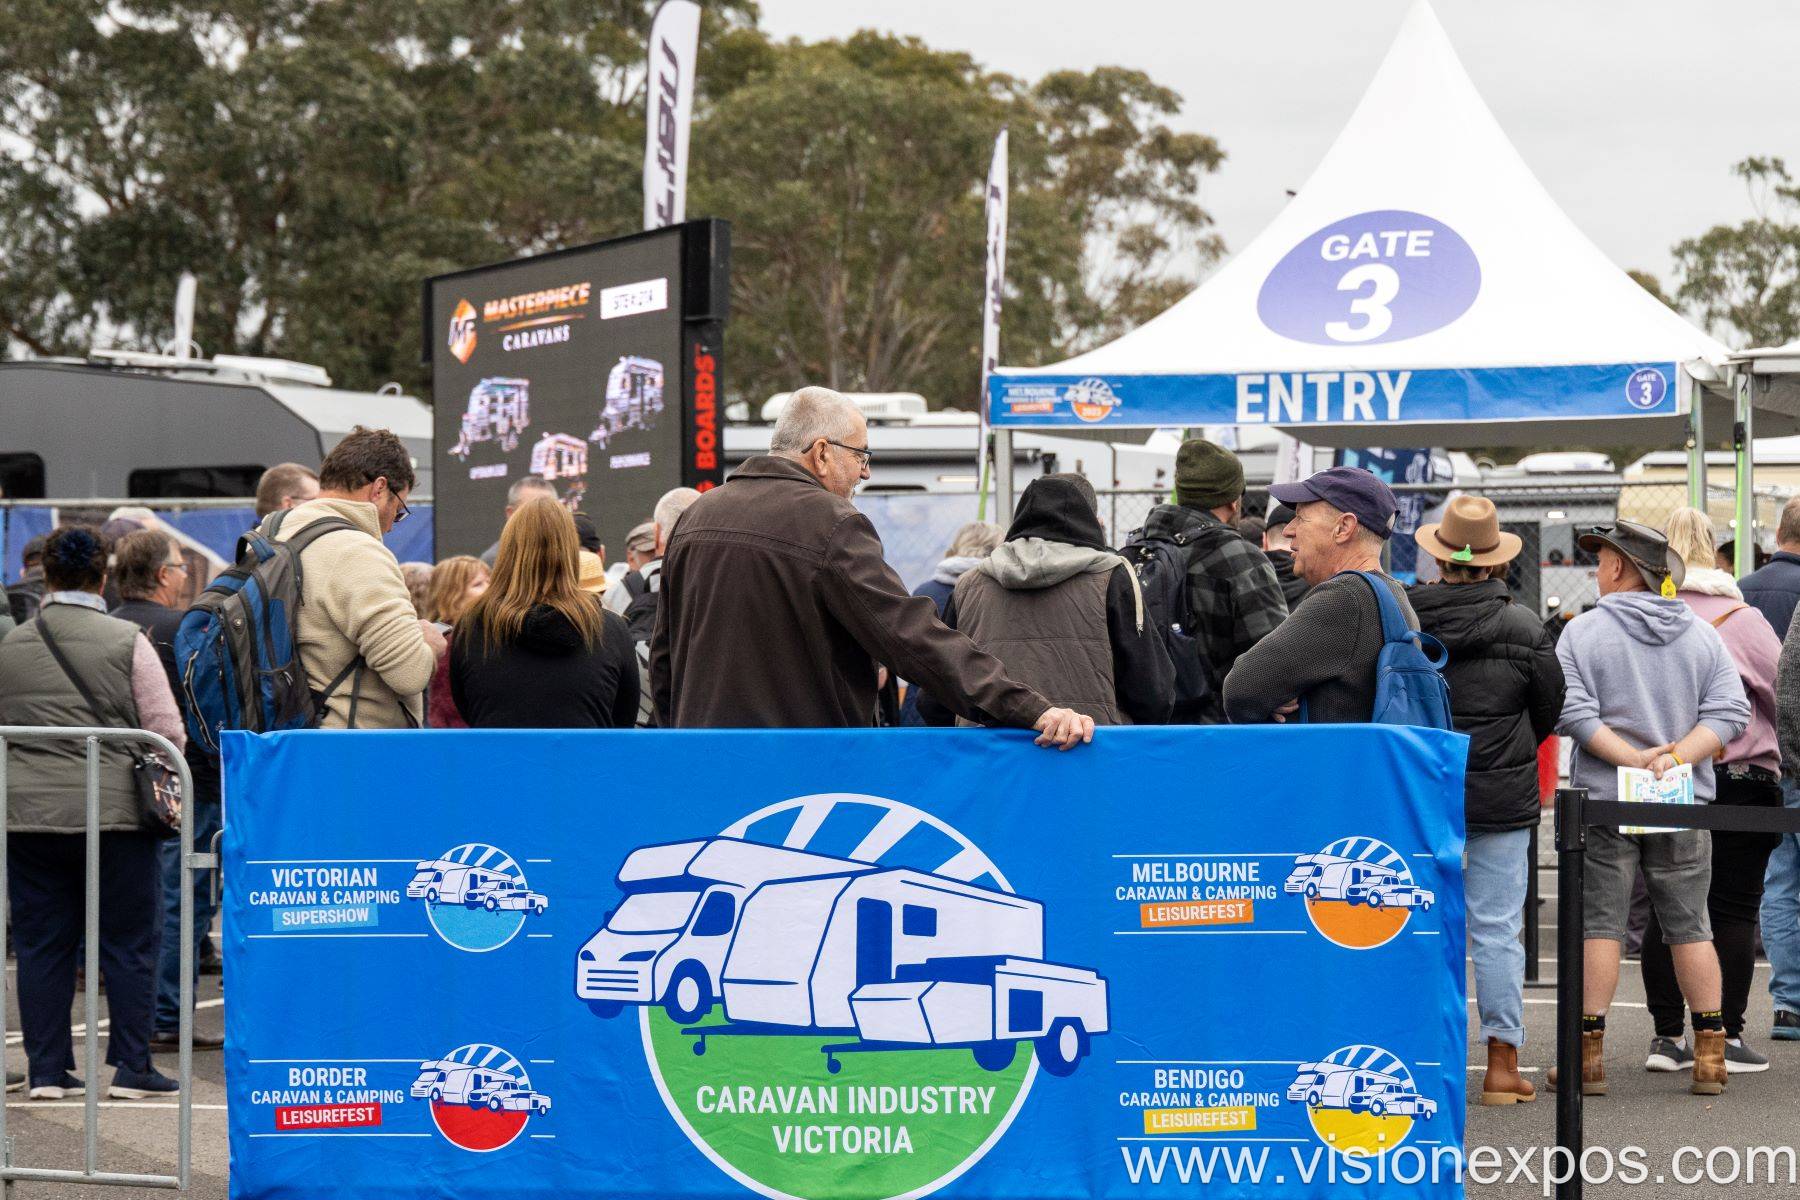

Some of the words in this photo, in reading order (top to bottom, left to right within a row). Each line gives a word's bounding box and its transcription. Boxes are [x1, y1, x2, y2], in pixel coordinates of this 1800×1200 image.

[1321, 230, 1434, 261] GATE
[483, 282, 592, 322] MASTERPIECE
[1325, 263, 1400, 342] 3
[502, 325, 571, 351] CARAVANS
[1636, 373, 1657, 382] GATE
[1236, 371, 1412, 423] ENTRY
[1640, 382, 1653, 405] 3
[694, 354, 717, 470] BOARDS
[271, 868, 378, 888] VICTORIAN
[1132, 861, 1260, 883] MELBOURNE
[249, 890, 318, 906] CARAVAN
[320, 890, 331, 905] &
[333, 890, 400, 905] CAMPING
[1115, 886, 1189, 901] CARAVAN
[1191, 886, 1202, 900] &
[1204, 885, 1277, 900] CAMPING
[282, 907, 369, 926] SUPERSHOW
[1148, 903, 1246, 923] LEISUREFEST
[288, 1067, 368, 1087] BORDER
[1154, 1068, 1244, 1089] BENDIGO
[251, 1090, 321, 1105] CARAVAN
[324, 1090, 333, 1104] &
[336, 1089, 404, 1104] CAMPING
[696, 1085, 838, 1114] CARAVAN
[848, 1086, 996, 1114] INDUSTRY
[1119, 1092, 1192, 1107] CARAVAN
[1194, 1092, 1204, 1106] &
[1207, 1092, 1280, 1107] CAMPING
[282, 1107, 375, 1125] LEISUREFEST
[1152, 1111, 1249, 1129] LEISUREFEST
[772, 1125, 914, 1154] VICTORIA
